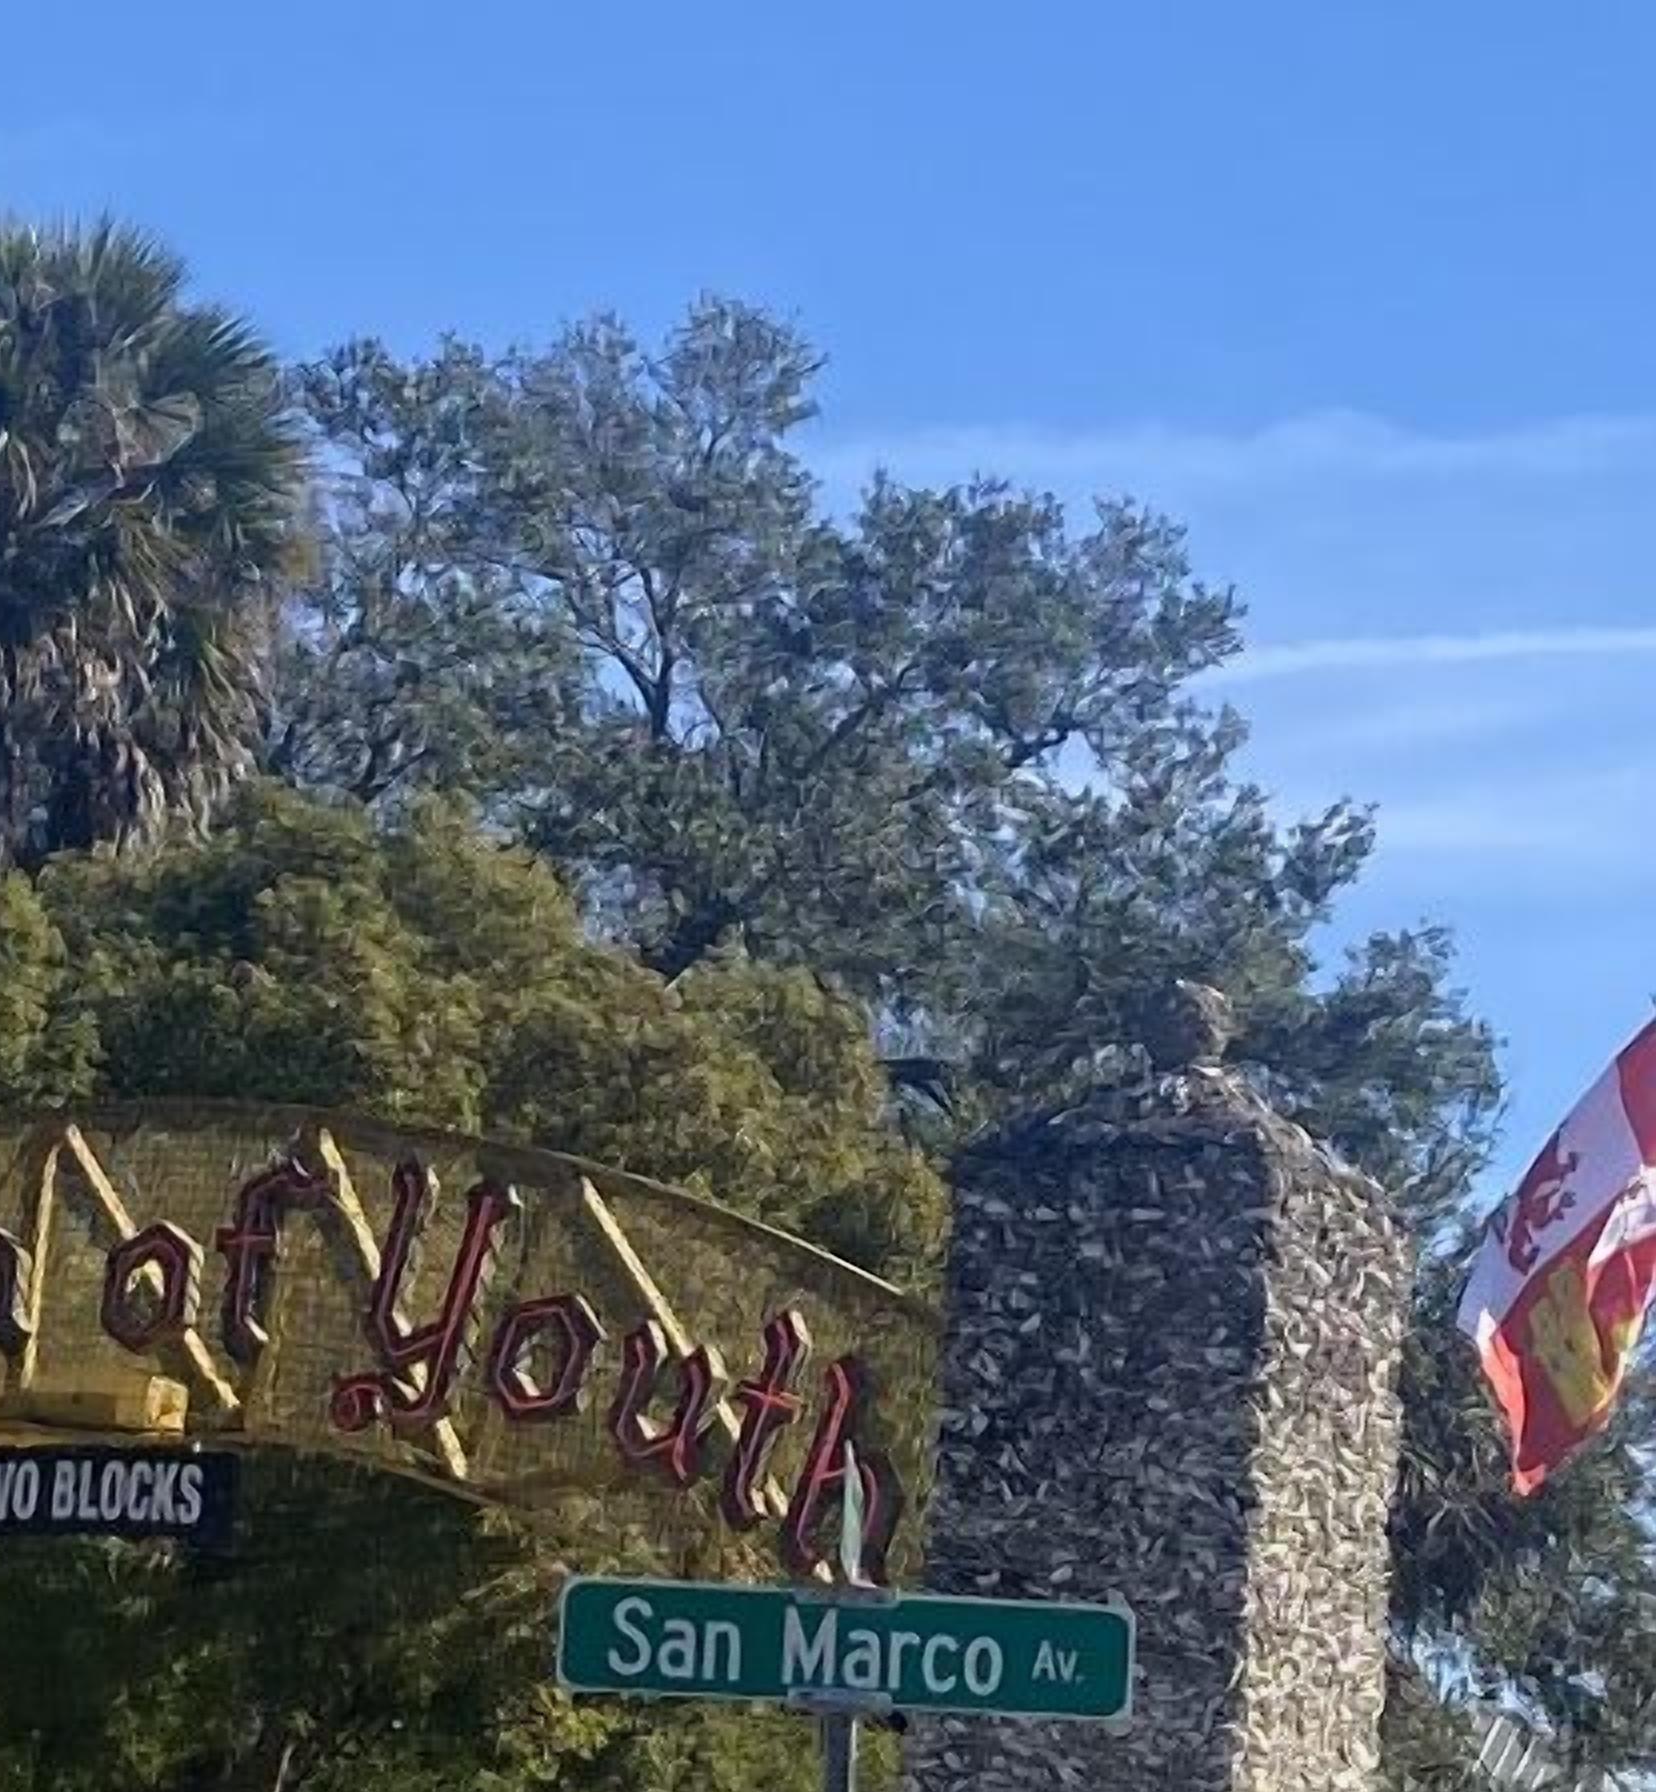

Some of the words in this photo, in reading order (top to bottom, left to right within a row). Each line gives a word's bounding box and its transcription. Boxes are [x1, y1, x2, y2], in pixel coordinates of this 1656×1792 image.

[101, 1130, 334, 1368] of
[331, 1150, 902, 1587] Youth
[51, 1459, 204, 1525] BLOCKS
[607, 1595, 742, 1682] San
[781, 1606, 1004, 1697] Marco
